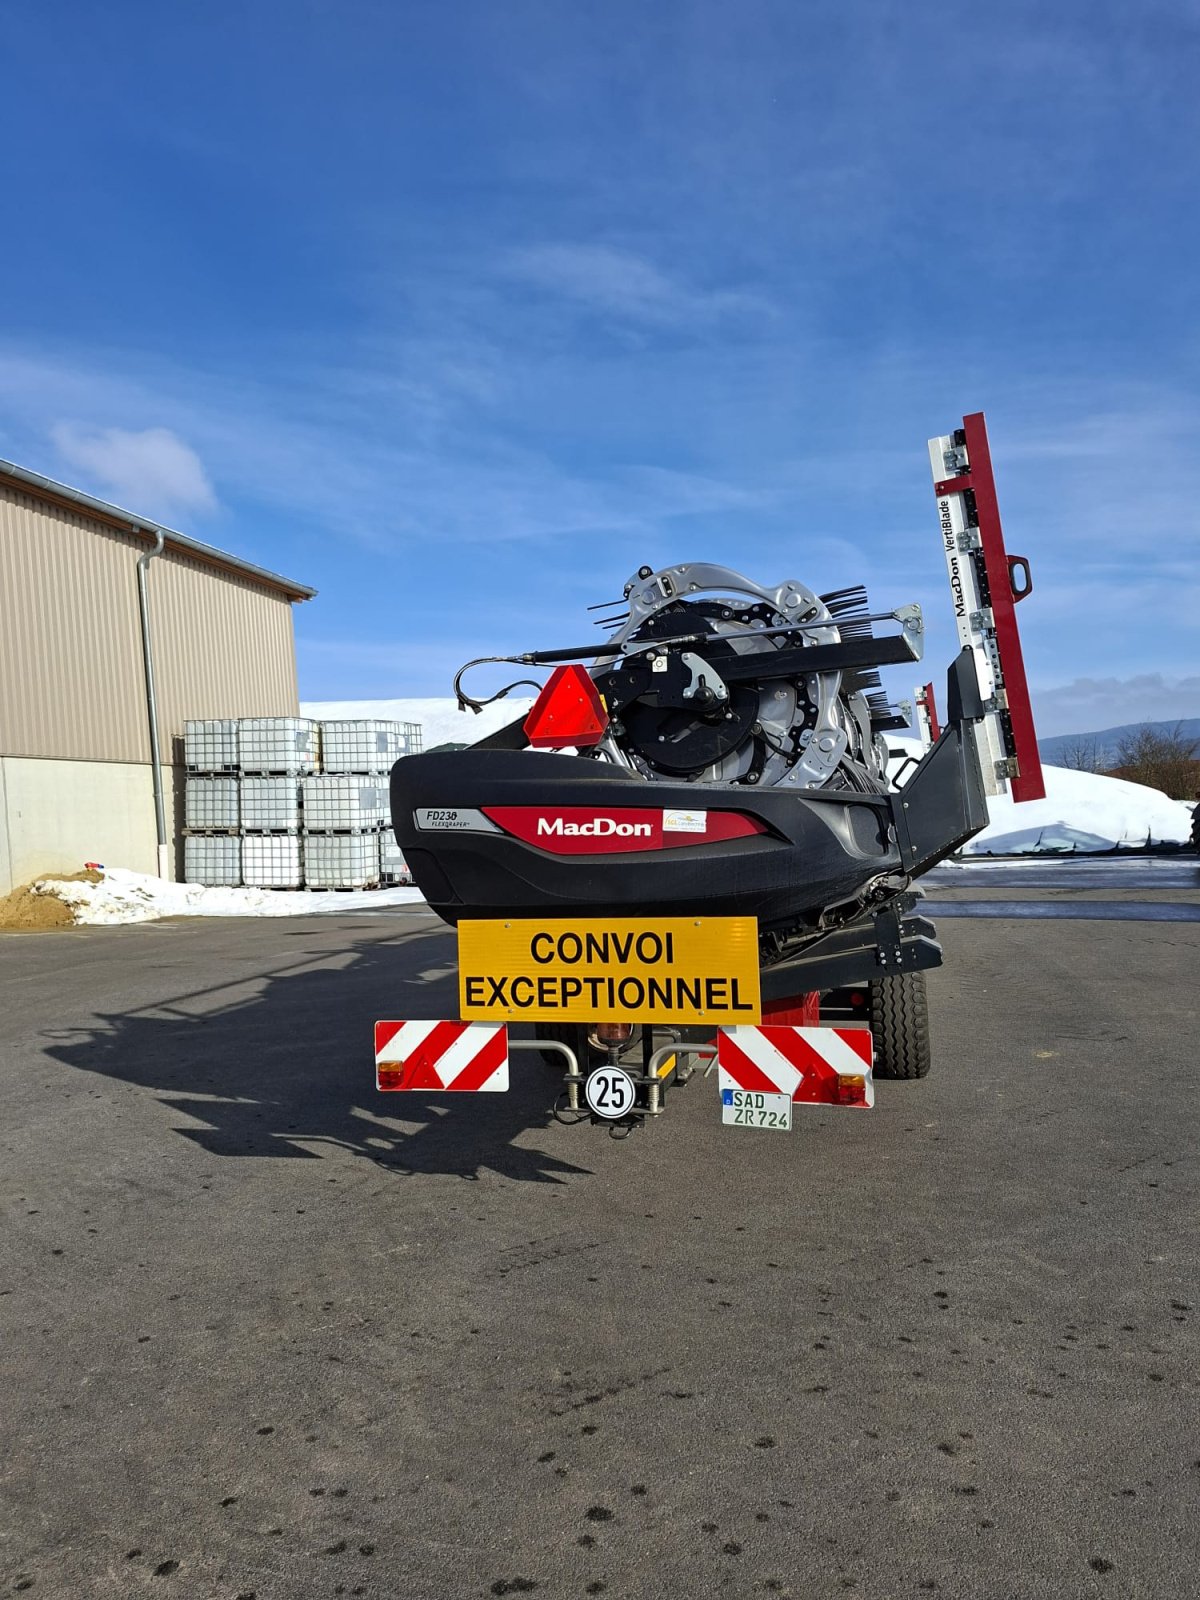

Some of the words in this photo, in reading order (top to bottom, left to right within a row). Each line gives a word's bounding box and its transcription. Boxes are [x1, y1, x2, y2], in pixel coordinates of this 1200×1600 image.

[939, 500, 956, 552] VertiBlade
[950, 557, 966, 617] MacDon
[537, 817, 652, 837] MacDon
[530, 932, 674, 965] CONVOI
[465, 976, 753, 1011] EXCEPTIONNEL
[596, 1076, 625, 1109] 25
[734, 1092, 765, 1109] SAD
[734, 1108, 754, 1125] ZR
[758, 1110, 788, 1128] 724
